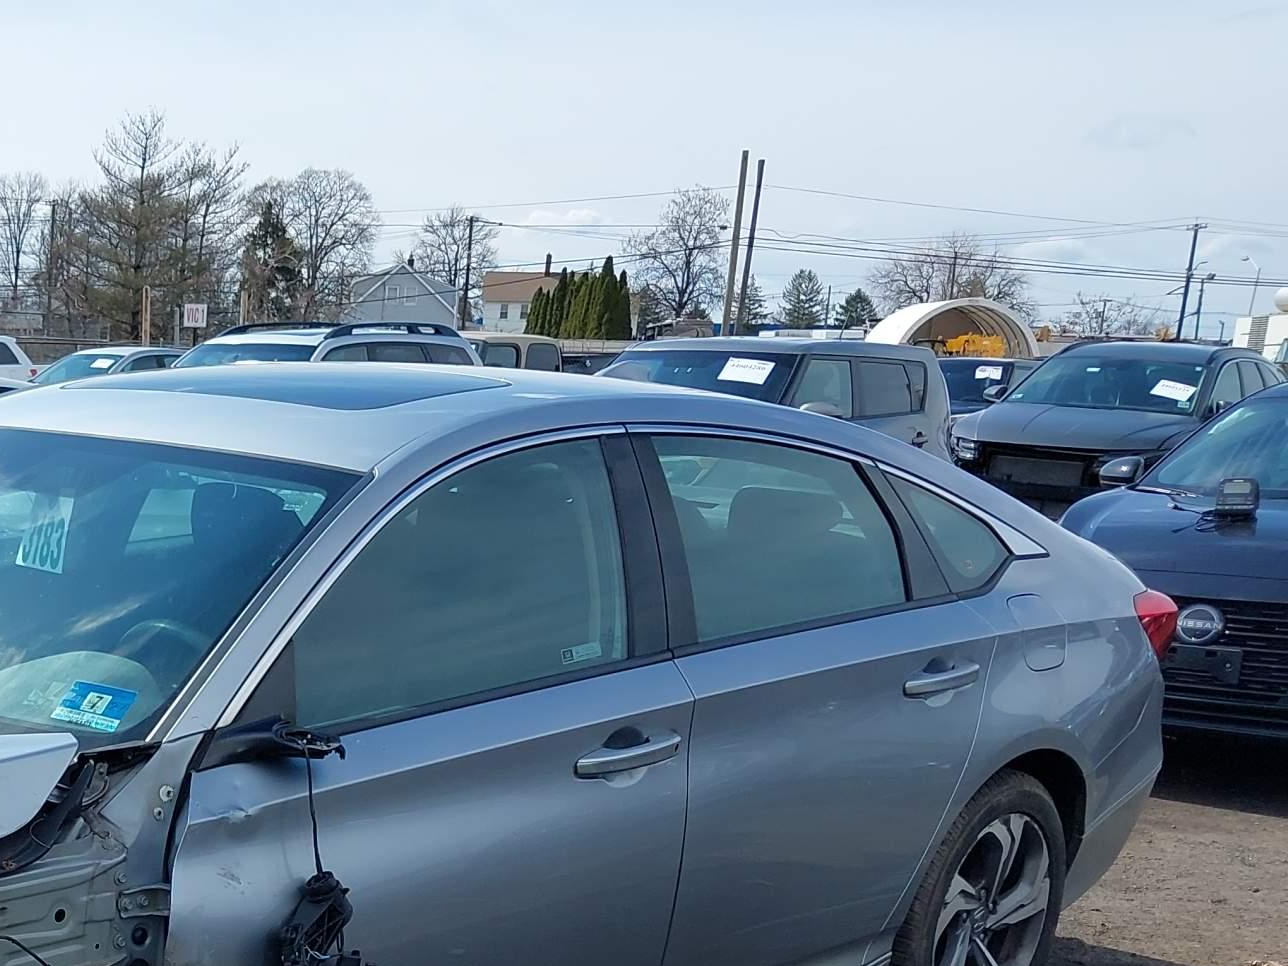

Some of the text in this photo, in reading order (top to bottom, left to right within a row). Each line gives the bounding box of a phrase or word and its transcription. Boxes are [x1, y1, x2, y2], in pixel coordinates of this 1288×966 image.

[187, 307, 200, 324] VIC
[1177, 619, 1223, 631] NISSAN
[87, 695, 105, 710] 7
